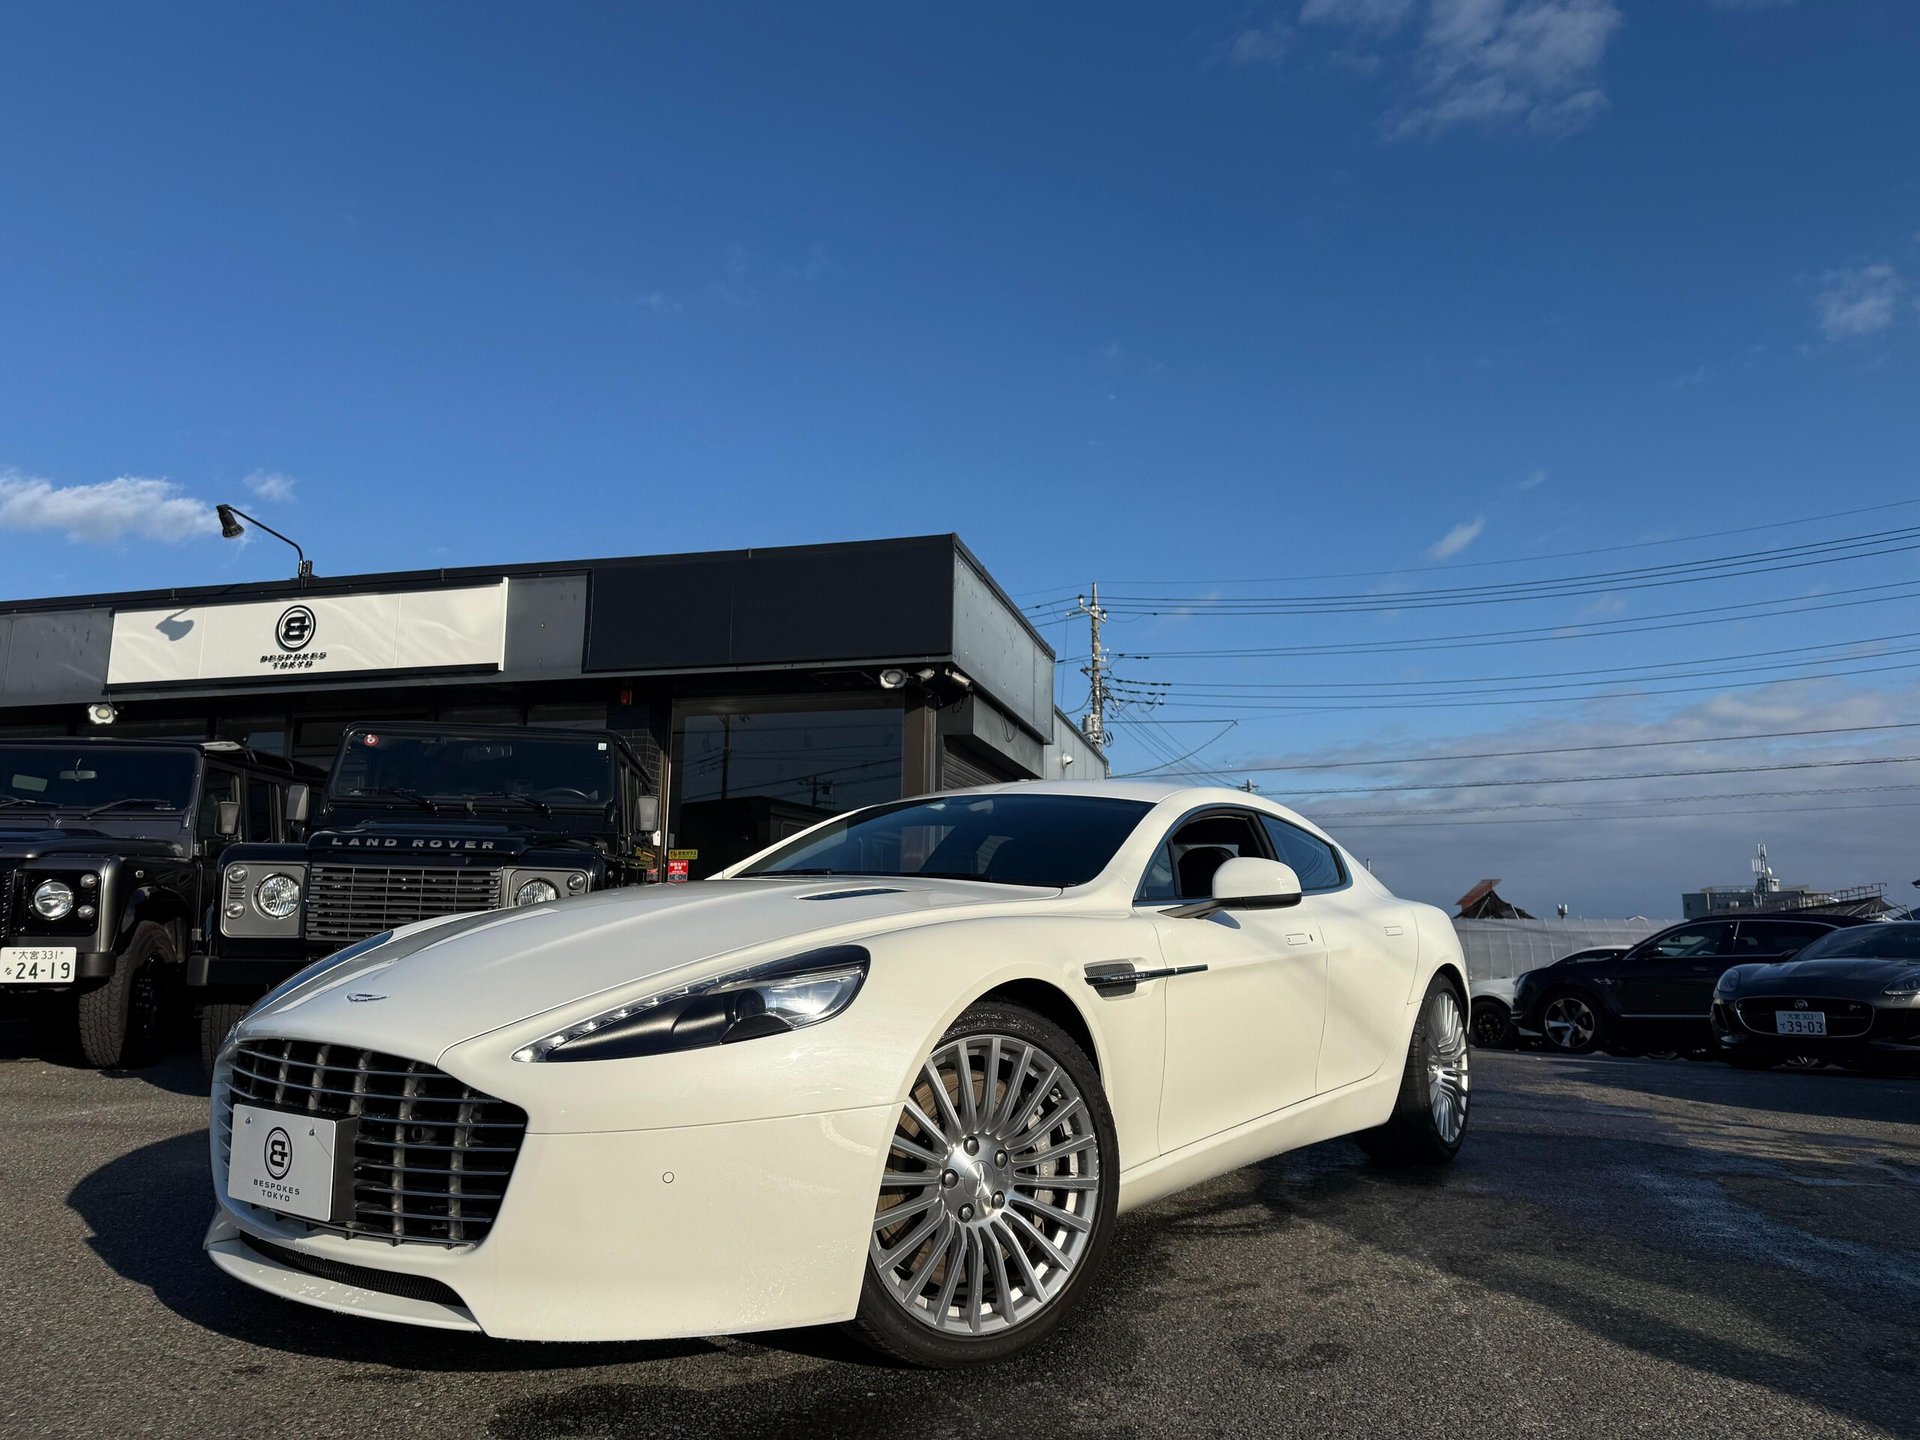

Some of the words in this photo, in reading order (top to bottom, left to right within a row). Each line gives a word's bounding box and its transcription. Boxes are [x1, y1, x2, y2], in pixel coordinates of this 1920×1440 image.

[260, 652, 327, 663] BESPOKES
[272, 660, 314, 670] TOKYO
[331, 837, 398, 847] LAND
[412, 839, 495, 849] ROVER
[15, 961, 71, 980] 24-19
[1787, 1020, 1824, 1034] 39-03
[253, 1178, 301, 1196] BESPOKES
[261, 1189, 291, 1202] TOKYO
